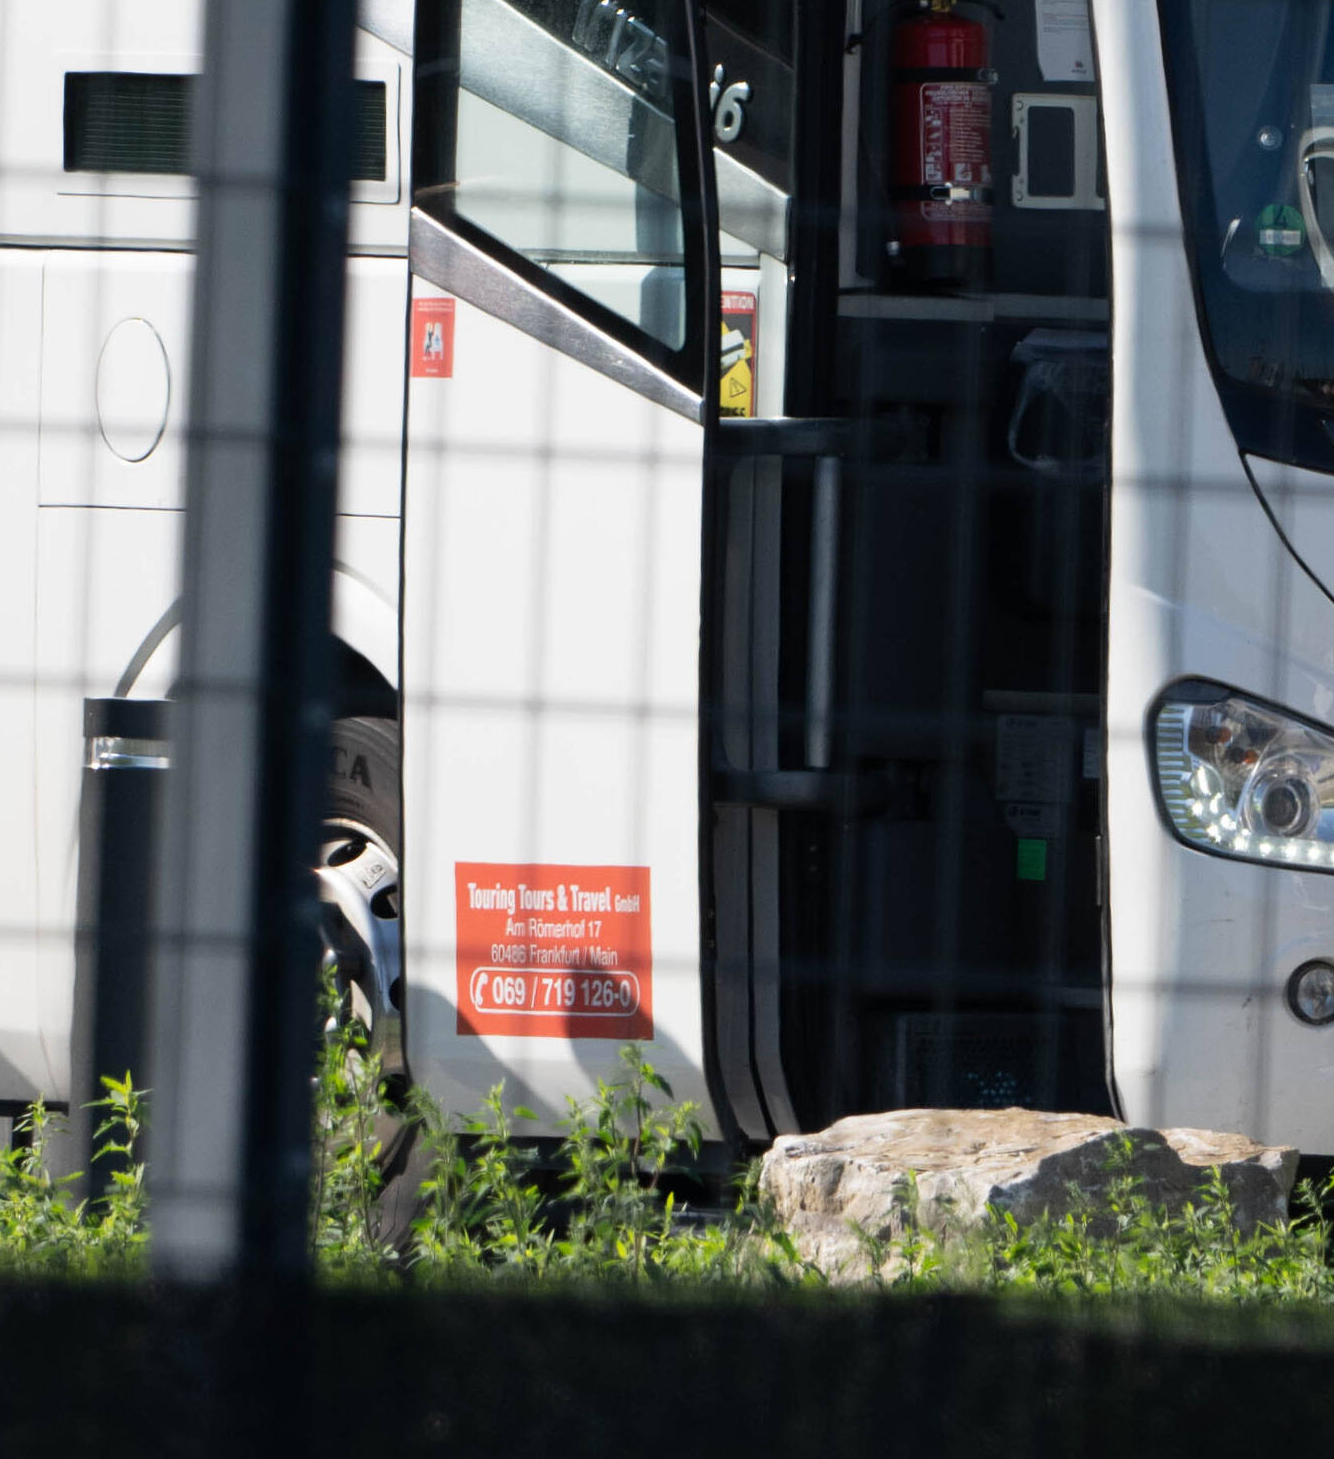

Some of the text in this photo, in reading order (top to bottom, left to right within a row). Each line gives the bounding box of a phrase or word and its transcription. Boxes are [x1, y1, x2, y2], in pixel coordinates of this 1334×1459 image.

[467, 882, 515, 915] Touring
[518, 884, 554, 912] Tours
[556, 884, 568, 912] &
[570, 884, 612, 912] Travel
[506, 918, 601, 938] Am Römerhof 17
[529, 944, 580, 965] Frankfurt
[589, 947, 618, 966] Main
[492, 976, 631, 1008] 069 / 719 126-0
